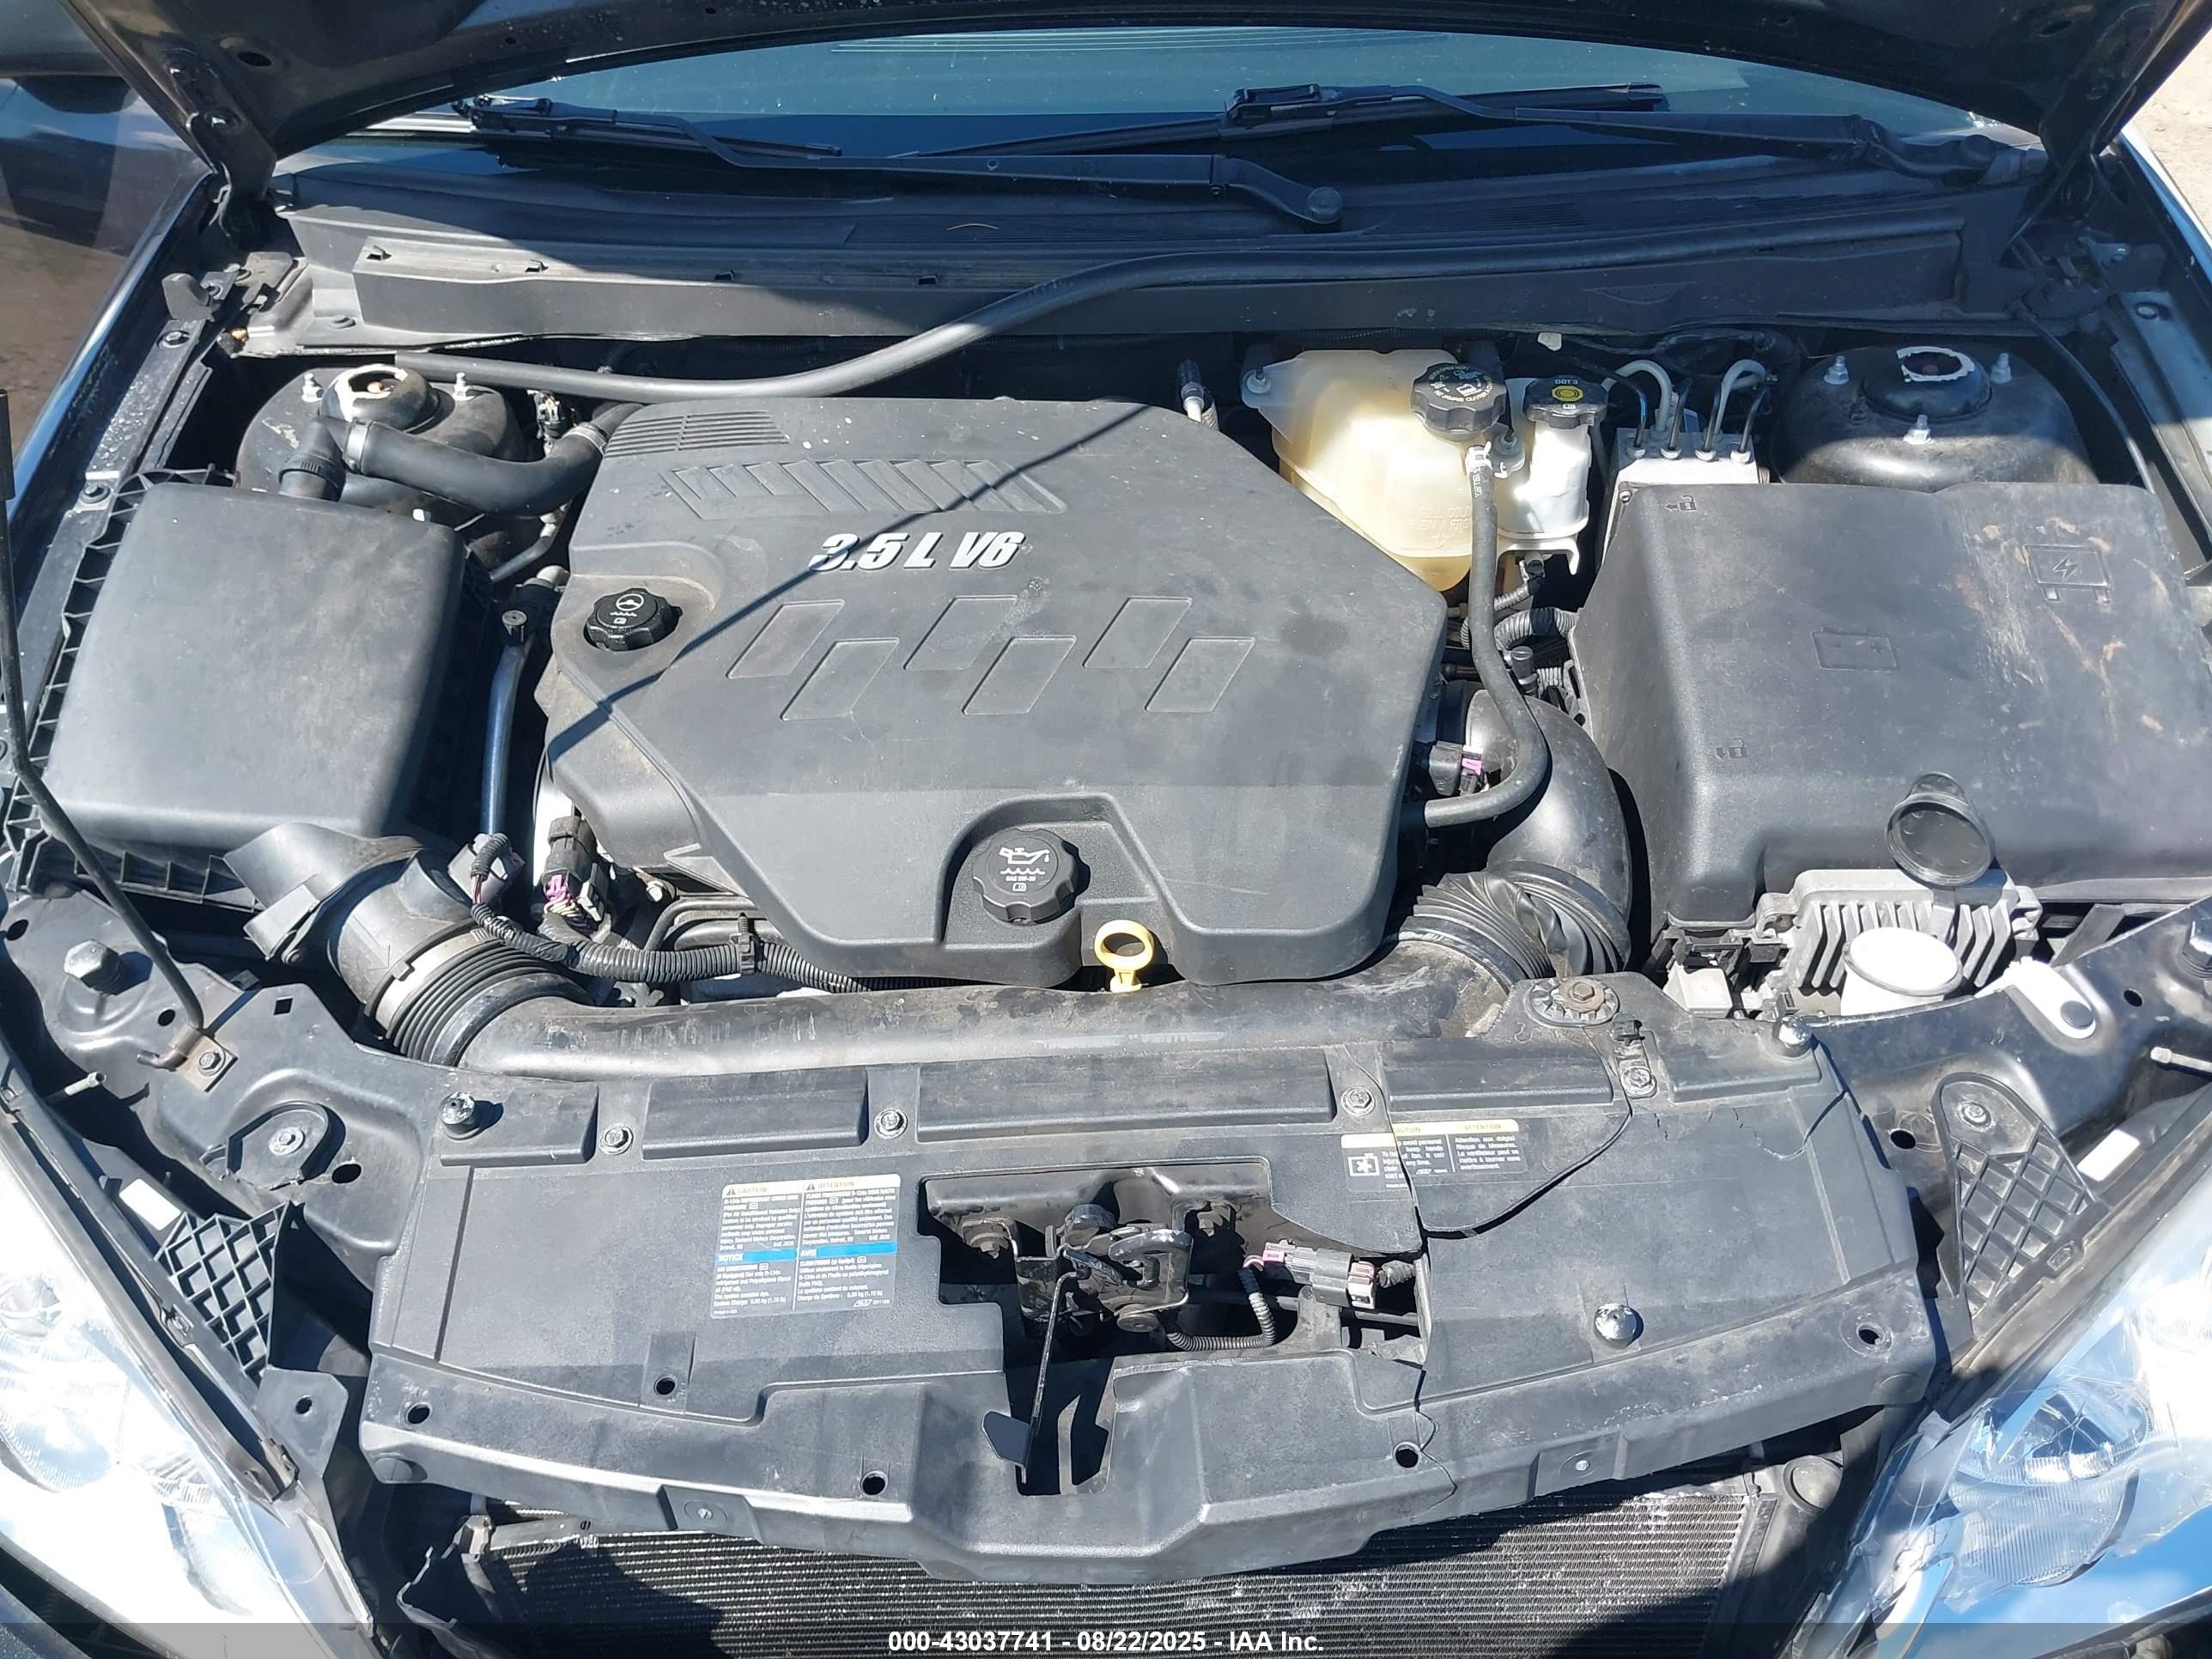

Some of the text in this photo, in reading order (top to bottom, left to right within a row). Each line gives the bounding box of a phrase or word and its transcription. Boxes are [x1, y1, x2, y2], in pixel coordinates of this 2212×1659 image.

[809, 532, 1026, 571] 3.5 L V6
